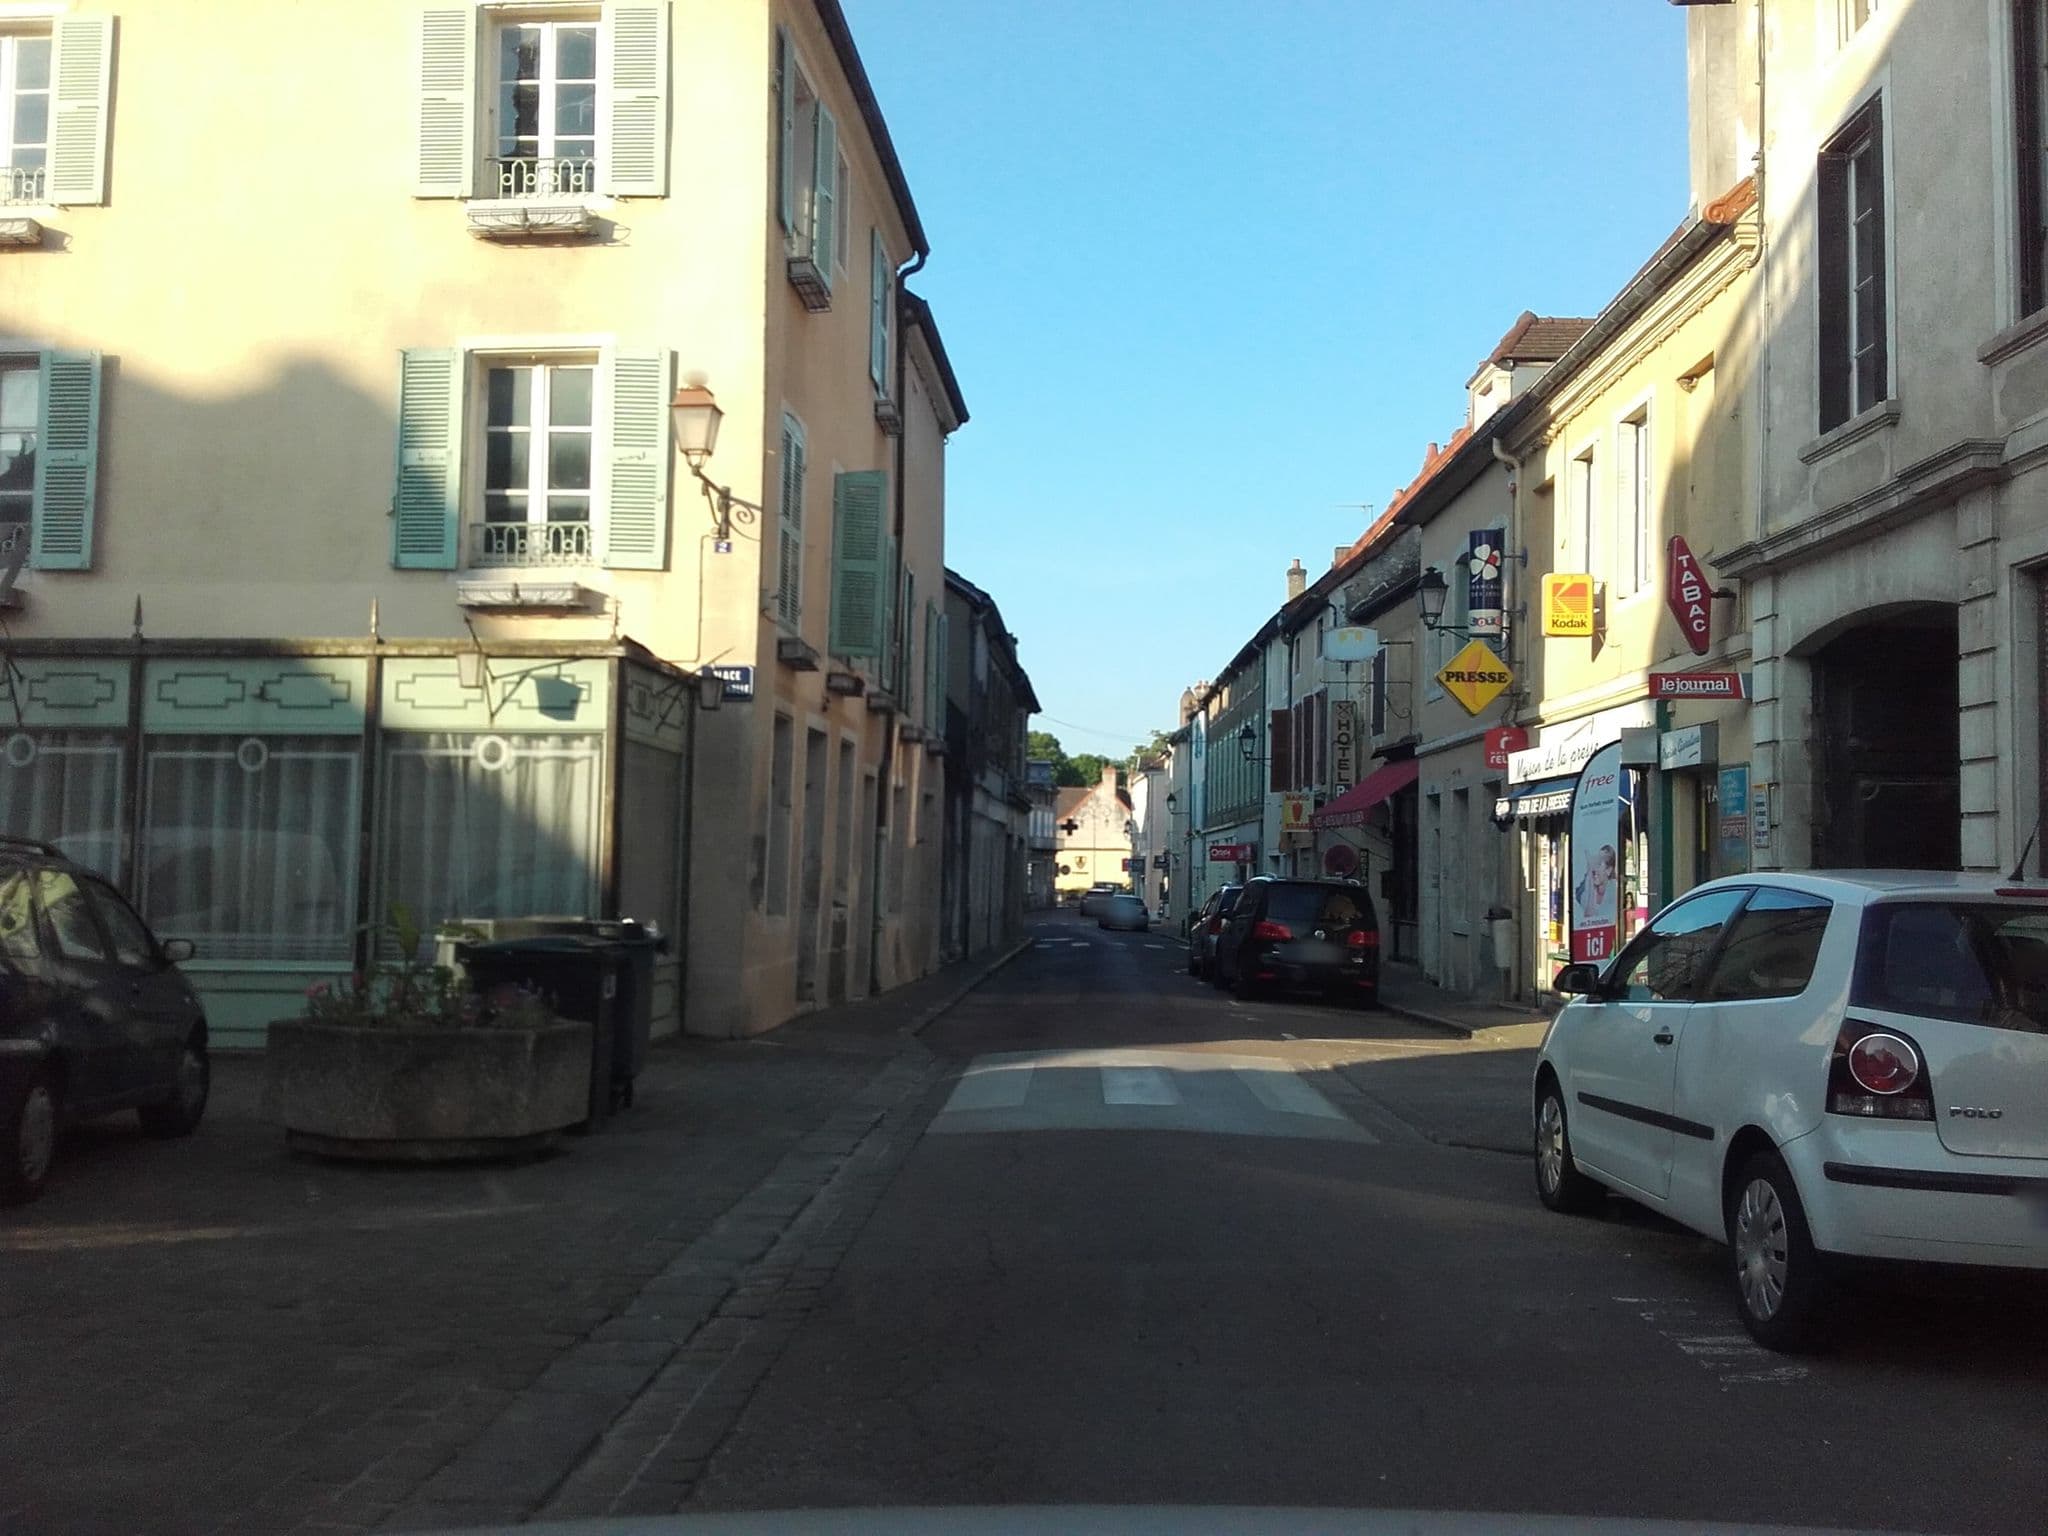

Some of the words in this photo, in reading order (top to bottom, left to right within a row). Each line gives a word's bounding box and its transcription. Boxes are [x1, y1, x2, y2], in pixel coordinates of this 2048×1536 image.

[1678, 555, 1706, 632] TABAC
[1551, 618, 1588, 629] Kodak
[1444, 671, 1508, 683] PRESSE
[1338, 720, 1350, 782] HOTEL
[1584, 774, 1615, 795] free
[1586, 931, 1604, 958] ici
[1949, 1106, 2003, 1119] POLO
